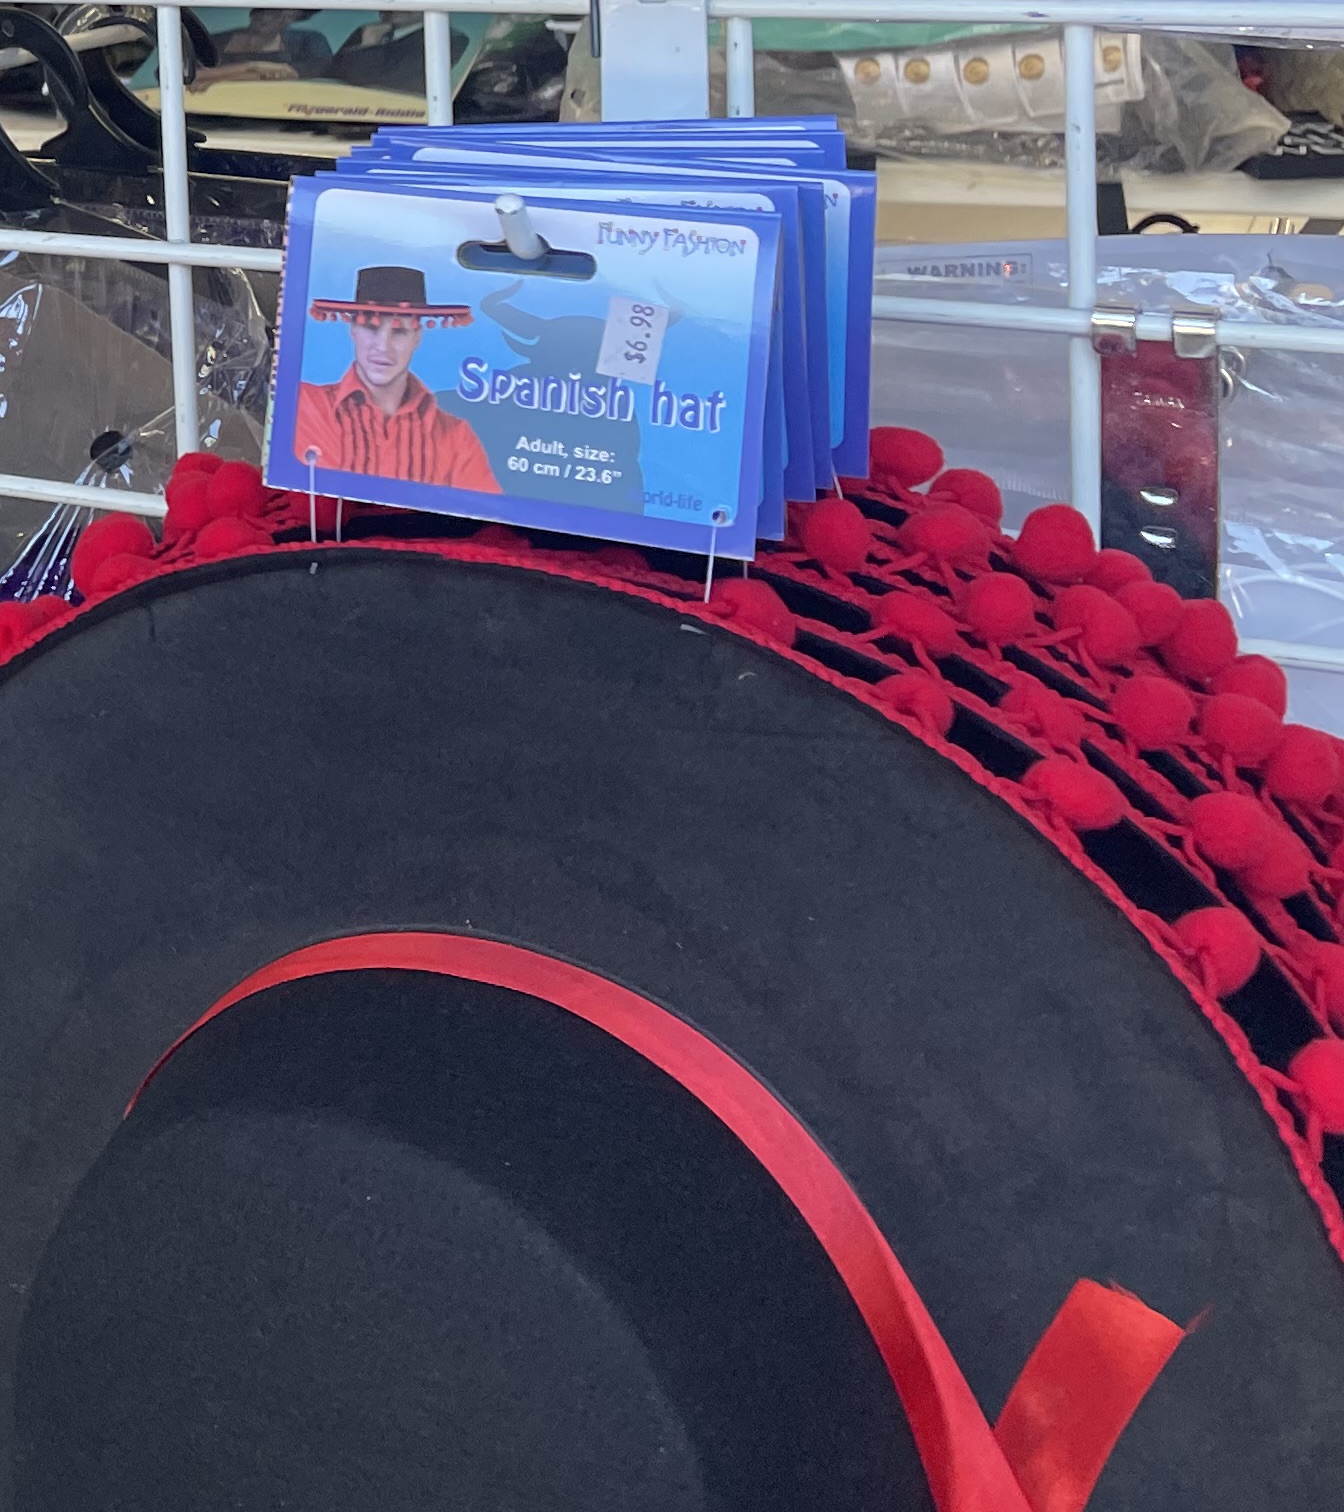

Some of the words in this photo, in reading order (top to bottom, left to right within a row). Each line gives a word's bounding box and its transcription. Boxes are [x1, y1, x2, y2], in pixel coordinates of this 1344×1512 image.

[624, 304, 655, 364] $6.98
[456, 356, 634, 422] Spanish
[650, 379, 726, 433] hat
[507, 456, 529, 472] 60
[533, 462, 560, 477] cm
[515, 436, 568, 458] Adult,
[574, 444, 616, 463] size:
